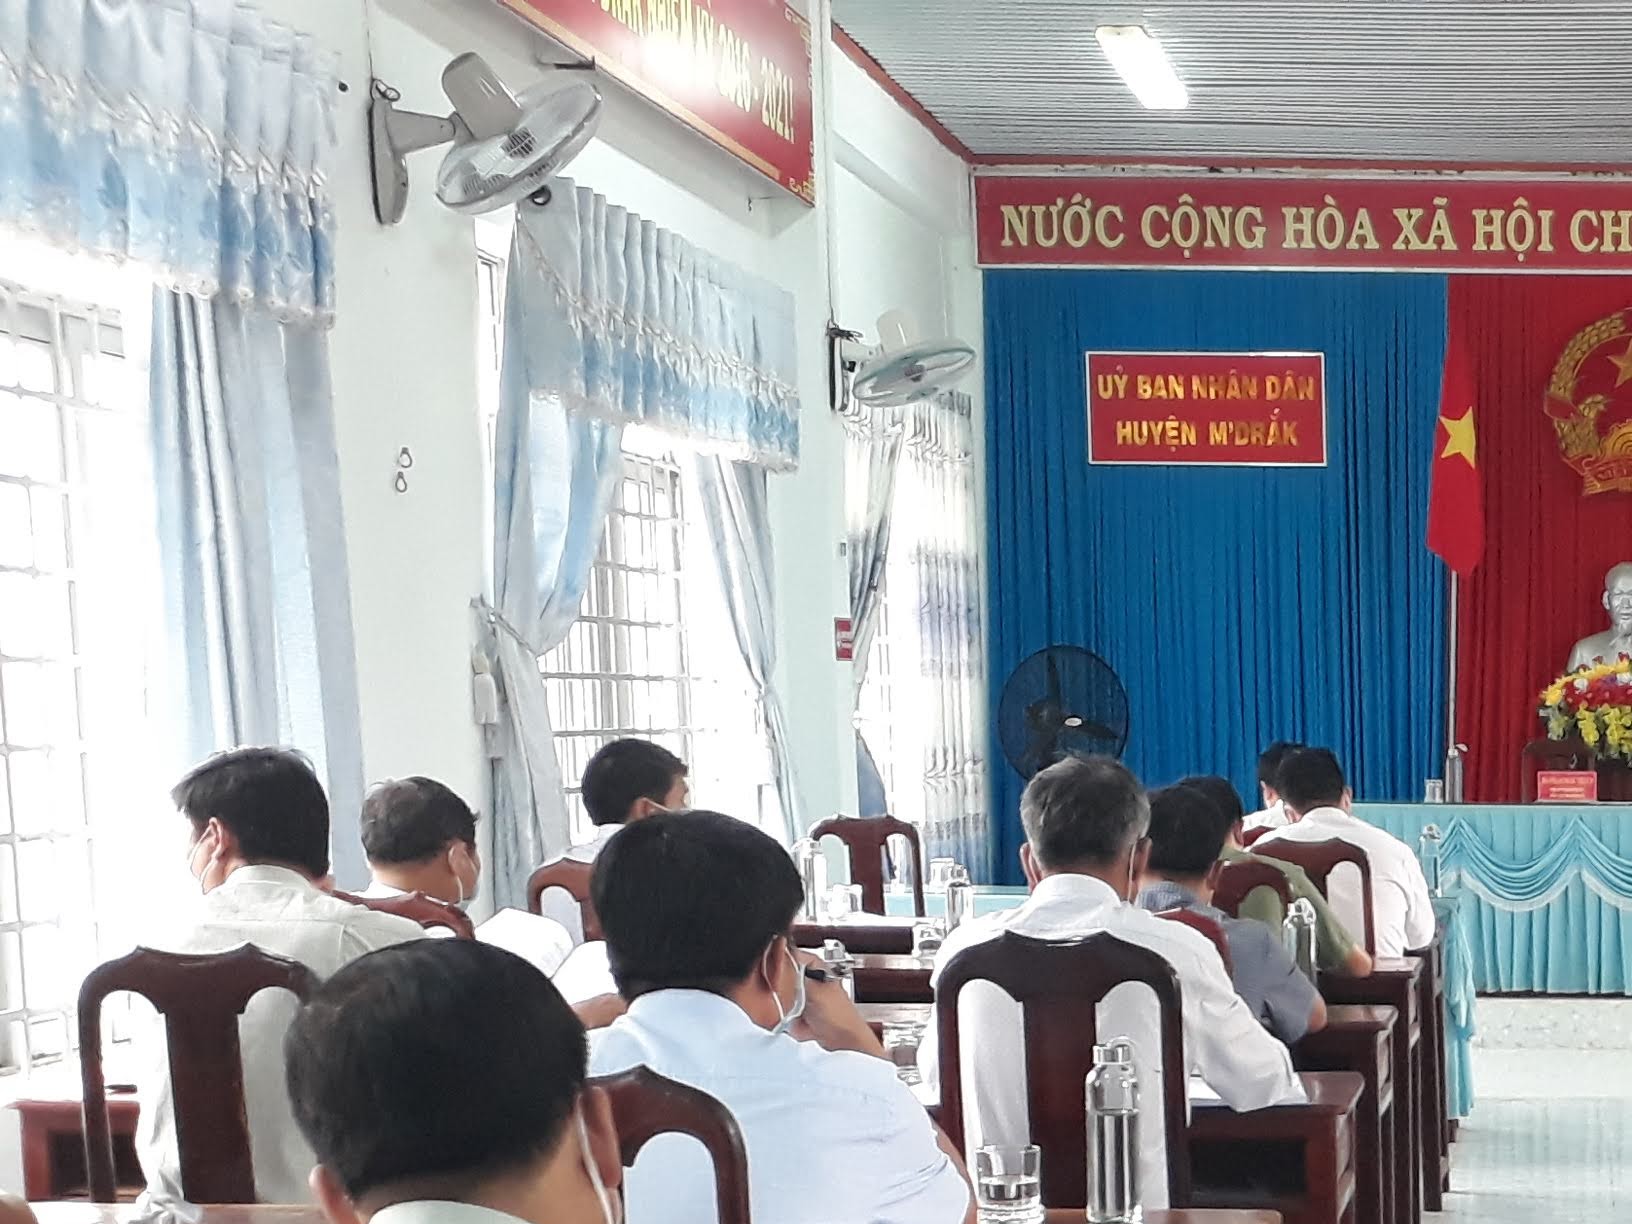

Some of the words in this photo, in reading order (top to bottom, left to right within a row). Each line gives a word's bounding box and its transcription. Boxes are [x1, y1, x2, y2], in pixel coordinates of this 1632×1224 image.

[1000, 192, 1125, 249] NƯỚC
[1140, 193, 1267, 259] CỘNG
[1281, 193, 1380, 251] HÒA
[1391, 196, 1458, 251] XÃ
[1471, 196, 1555, 262] HỘI
[1136, 374, 1185, 400] BAN
[1191, 368, 1258, 401] NHÂN
[1264, 369, 1315, 401] DÂN
[1116, 414, 1197, 453] HUYỆN
